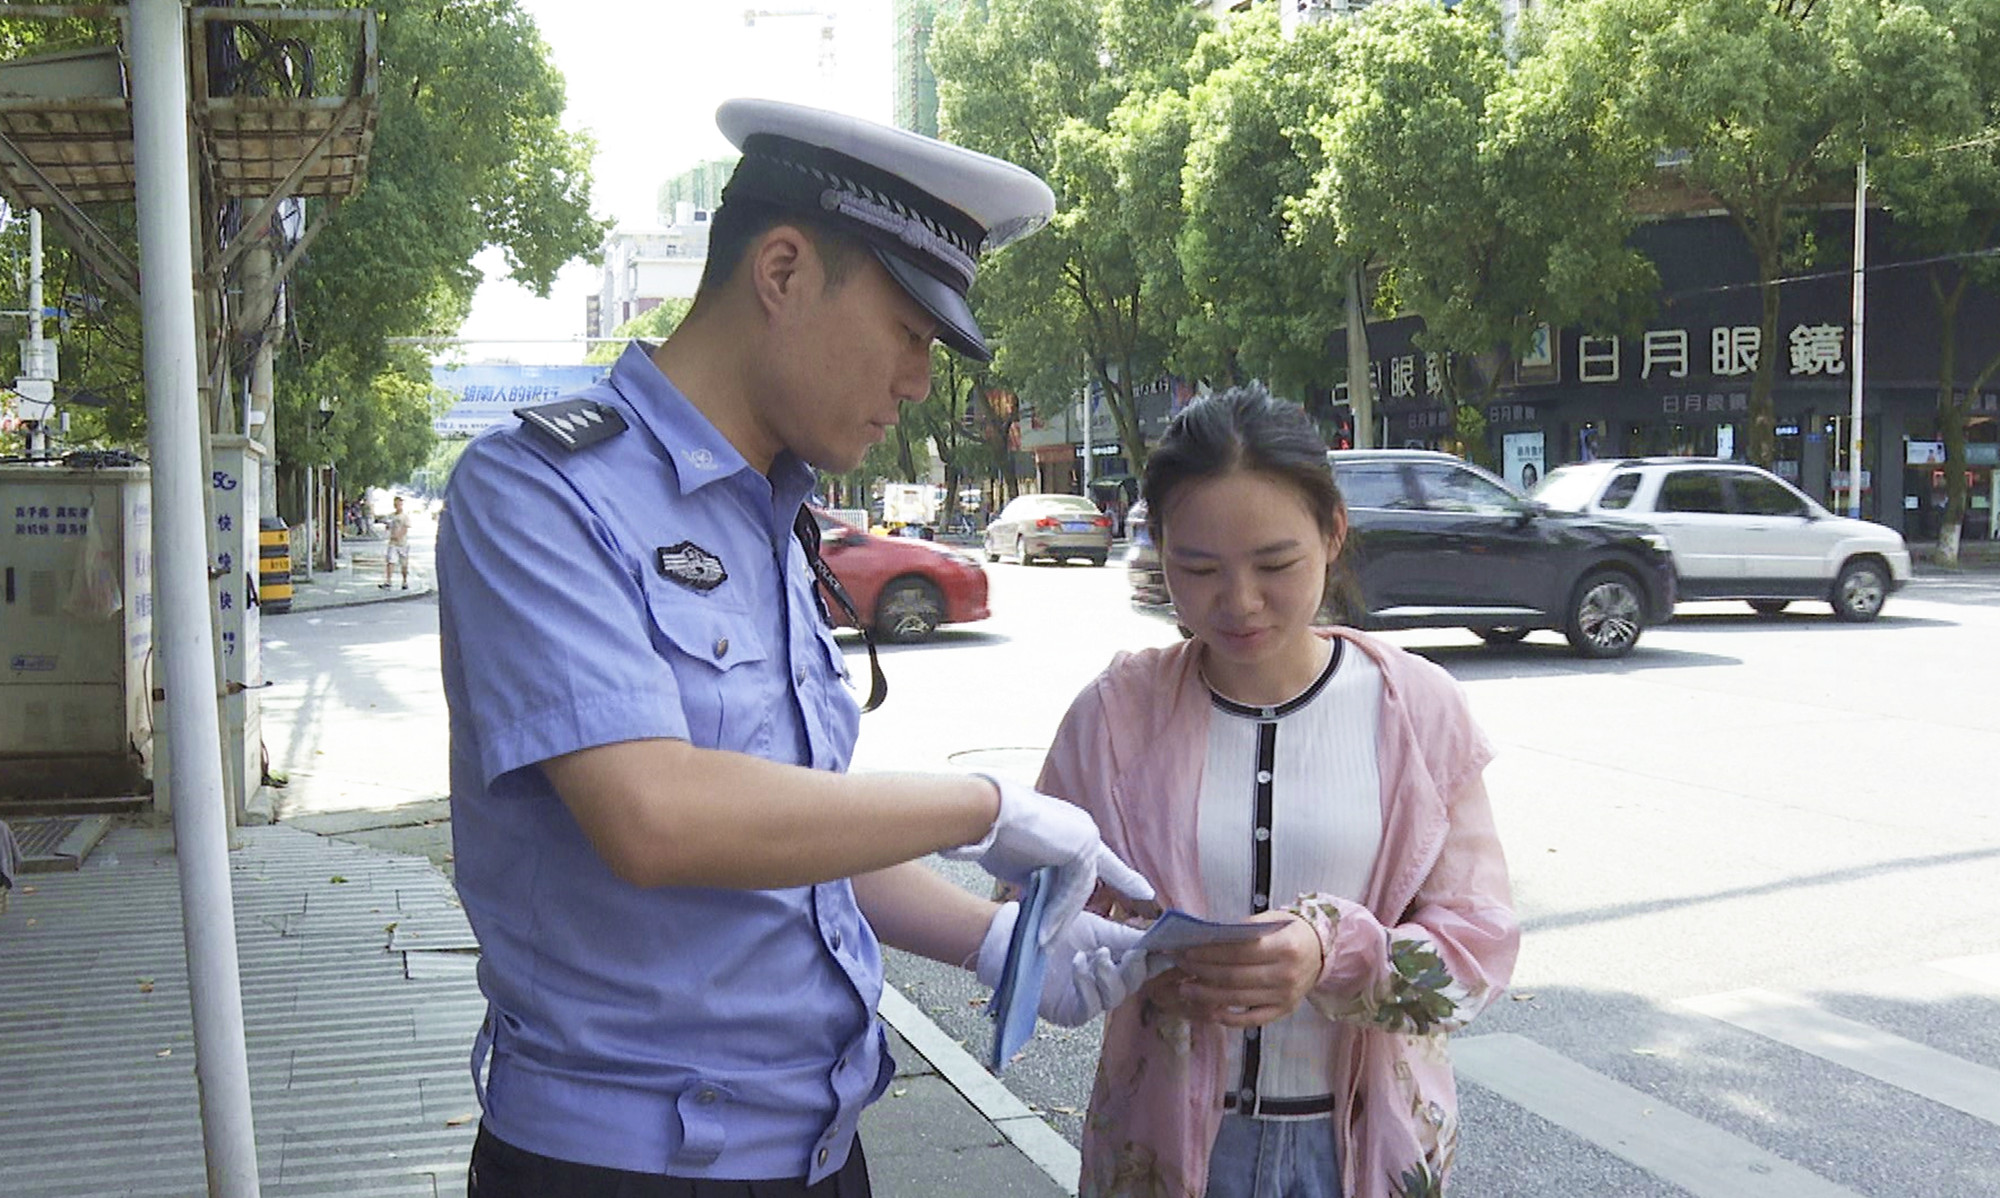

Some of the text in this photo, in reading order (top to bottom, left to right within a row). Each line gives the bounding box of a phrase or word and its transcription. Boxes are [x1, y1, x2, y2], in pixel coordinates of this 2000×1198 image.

[1579, 324, 1845, 382] 日月眼鏡
[461, 385, 560, 402] 湖南人的银行
[213, 471, 237, 490] 5G
